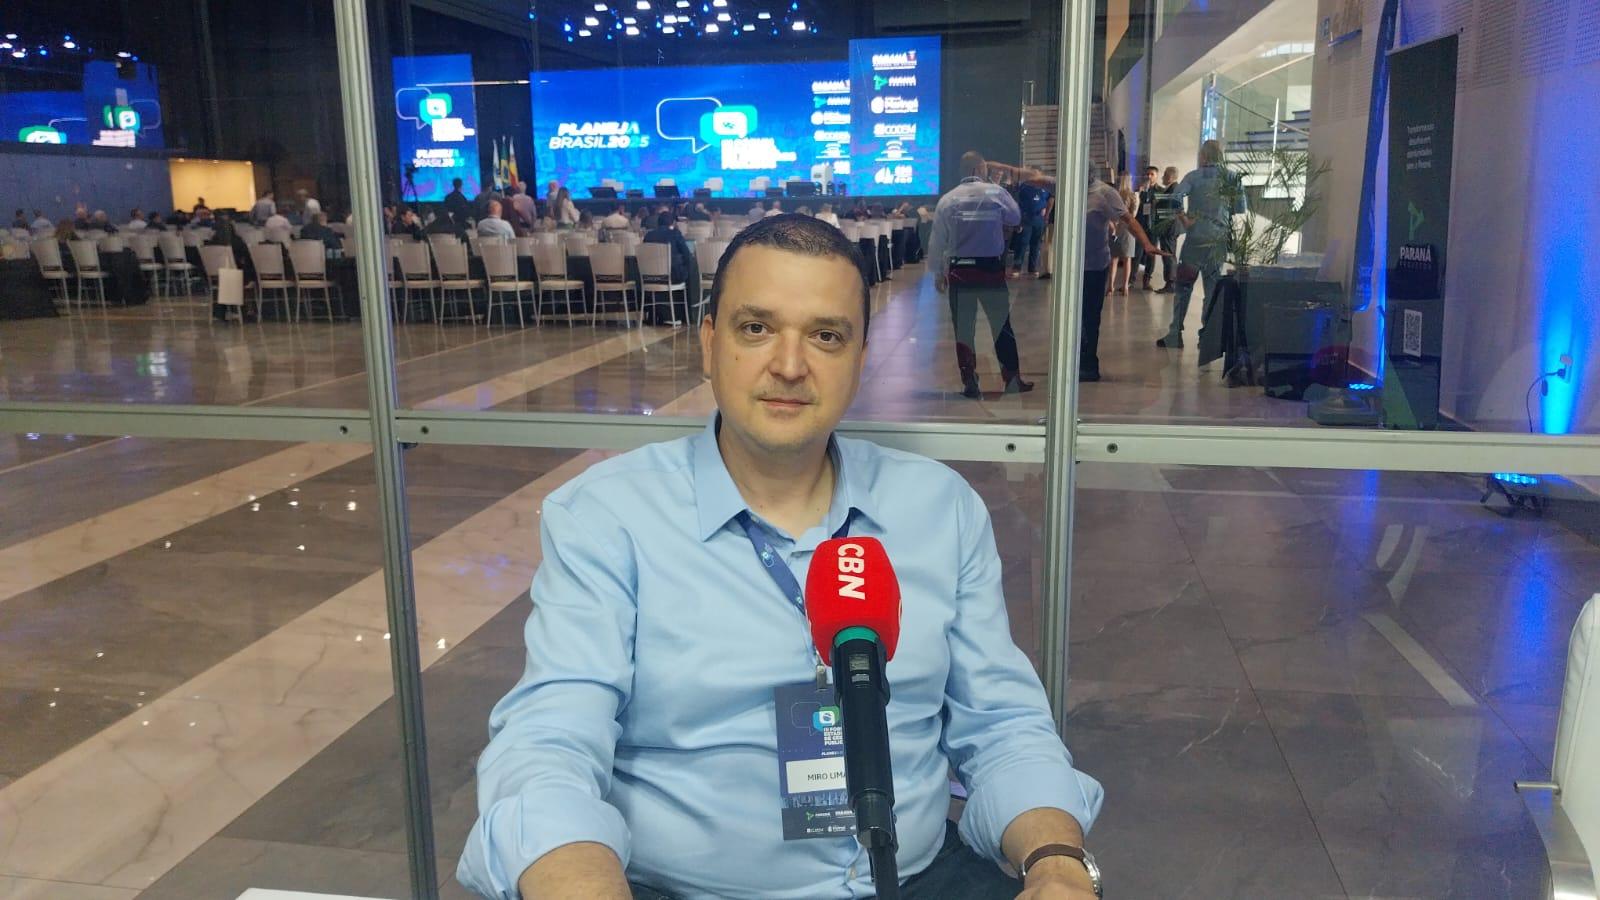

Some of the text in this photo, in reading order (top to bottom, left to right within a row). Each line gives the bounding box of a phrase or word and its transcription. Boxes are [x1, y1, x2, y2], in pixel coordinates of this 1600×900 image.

[1400, 245, 1431, 262] PARANÁ
[837, 543, 866, 600] CBN
[807, 773, 828, 781] MIRO
